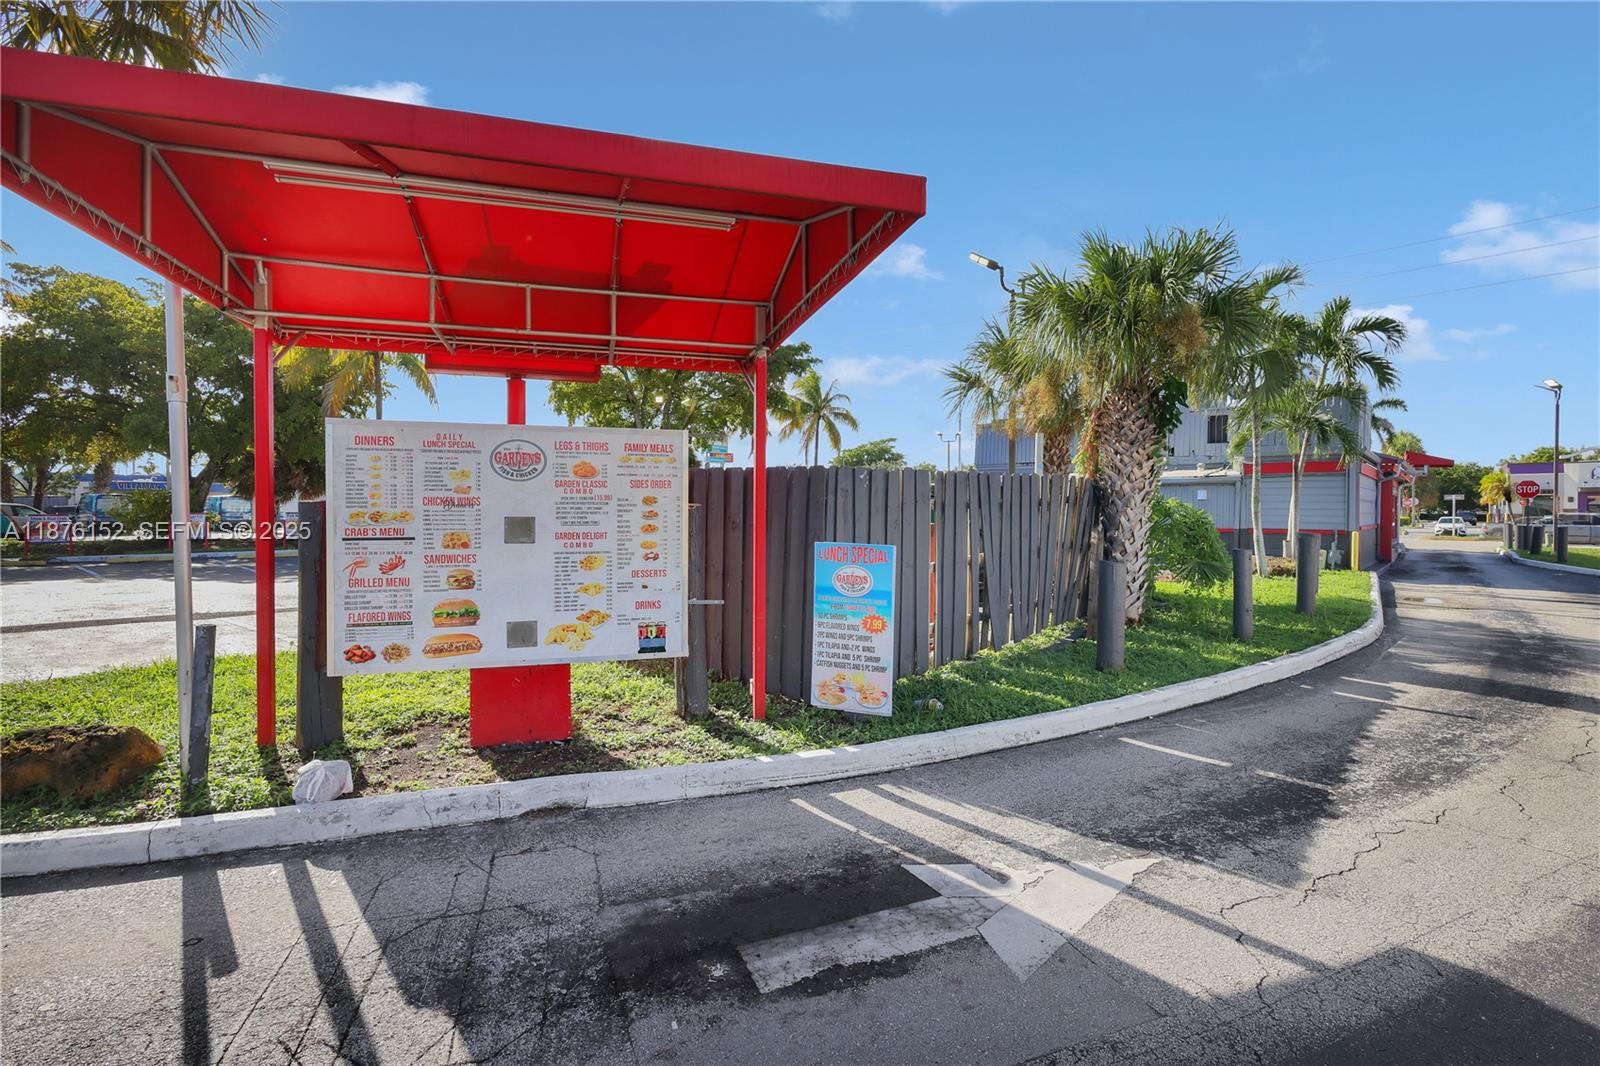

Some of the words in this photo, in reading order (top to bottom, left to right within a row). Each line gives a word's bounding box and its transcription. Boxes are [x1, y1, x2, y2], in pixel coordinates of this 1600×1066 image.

[354, 435, 395, 446] DINNERS
[423, 440, 446, 448] LUNCH
[448, 440, 476, 448] SPECIAL
[554, 441, 573, 451] LEGS
[575, 441, 580, 451] &
[582, 442, 609, 451] THIGHS
[624, 443, 648, 453] FAMILY
[650, 443, 674, 453] MEALS
[494, 451, 541, 467] GARDENS
[498, 465, 510, 476] FISH
[515, 466, 538, 478] CHICKEN
[554, 480, 580, 488] GARDEN
[582, 480, 608, 488] CLASSIC
[629, 480, 648, 489] SIDES
[650, 480, 672, 489] ORDER
[1516, 485, 1539, 494] STOP
[422, 496, 455, 506] CHICKEN
[456, 497, 481, 506] WINGS
[344, 527, 377, 537] CRAB'S
[380, 527, 405, 537] MENU
[554, 531, 580, 541] GARDEN
[581, 531, 608, 540] DELIGHT
[563, 541, 593, 549] COMBO
[424, 553, 477, 565] SANDWICHES
[818, 546, 849, 562] LUNCH
[851, 545, 888, 564] SPECIAL
[631, 569, 667, 578] DESSERTS
[348, 577, 383, 589] GRILLED
[386, 577, 411, 588] MENU
[836, 574, 869, 586] GARDENS
[635, 600, 662, 611] DRINKS
[348, 613, 386, 623] FLAFORED
[387, 611, 412, 621] WINGS
[834, 662, 852, 670] NUGGETS
